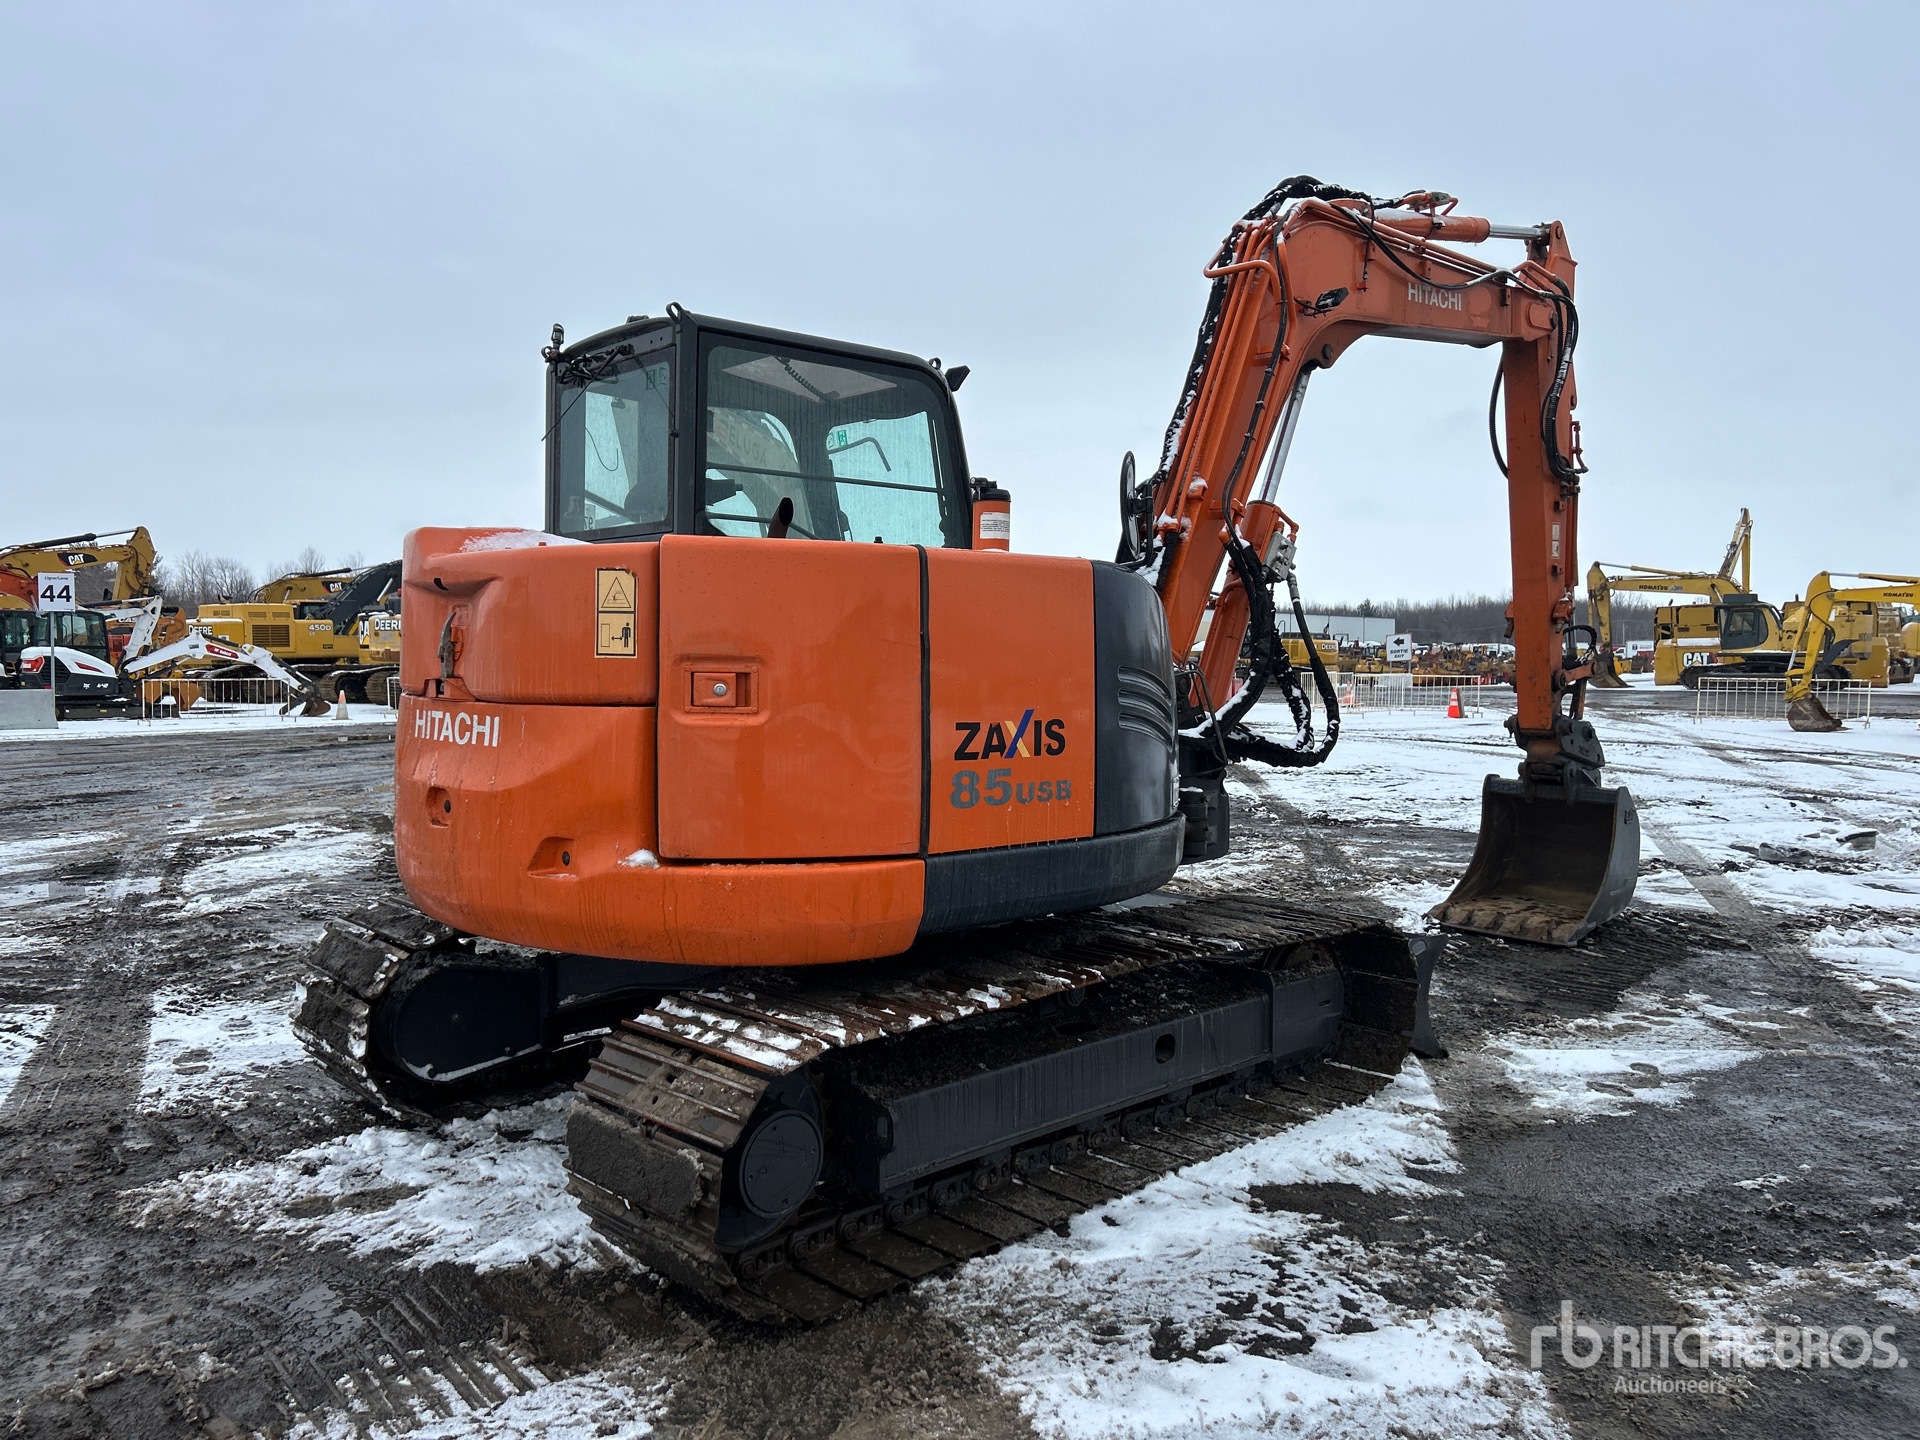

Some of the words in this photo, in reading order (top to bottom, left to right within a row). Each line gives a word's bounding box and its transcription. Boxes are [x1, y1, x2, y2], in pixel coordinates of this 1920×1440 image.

[1407, 282, 1462, 311] HITACHI
[68, 553, 84, 566] CAT
[40, 584, 72, 603] 44
[329, 582, 342, 592] CAT
[1683, 652, 1710, 667] CAT
[414, 709, 500, 747] HITACHI
[953, 708, 1066, 761] ZAXIS
